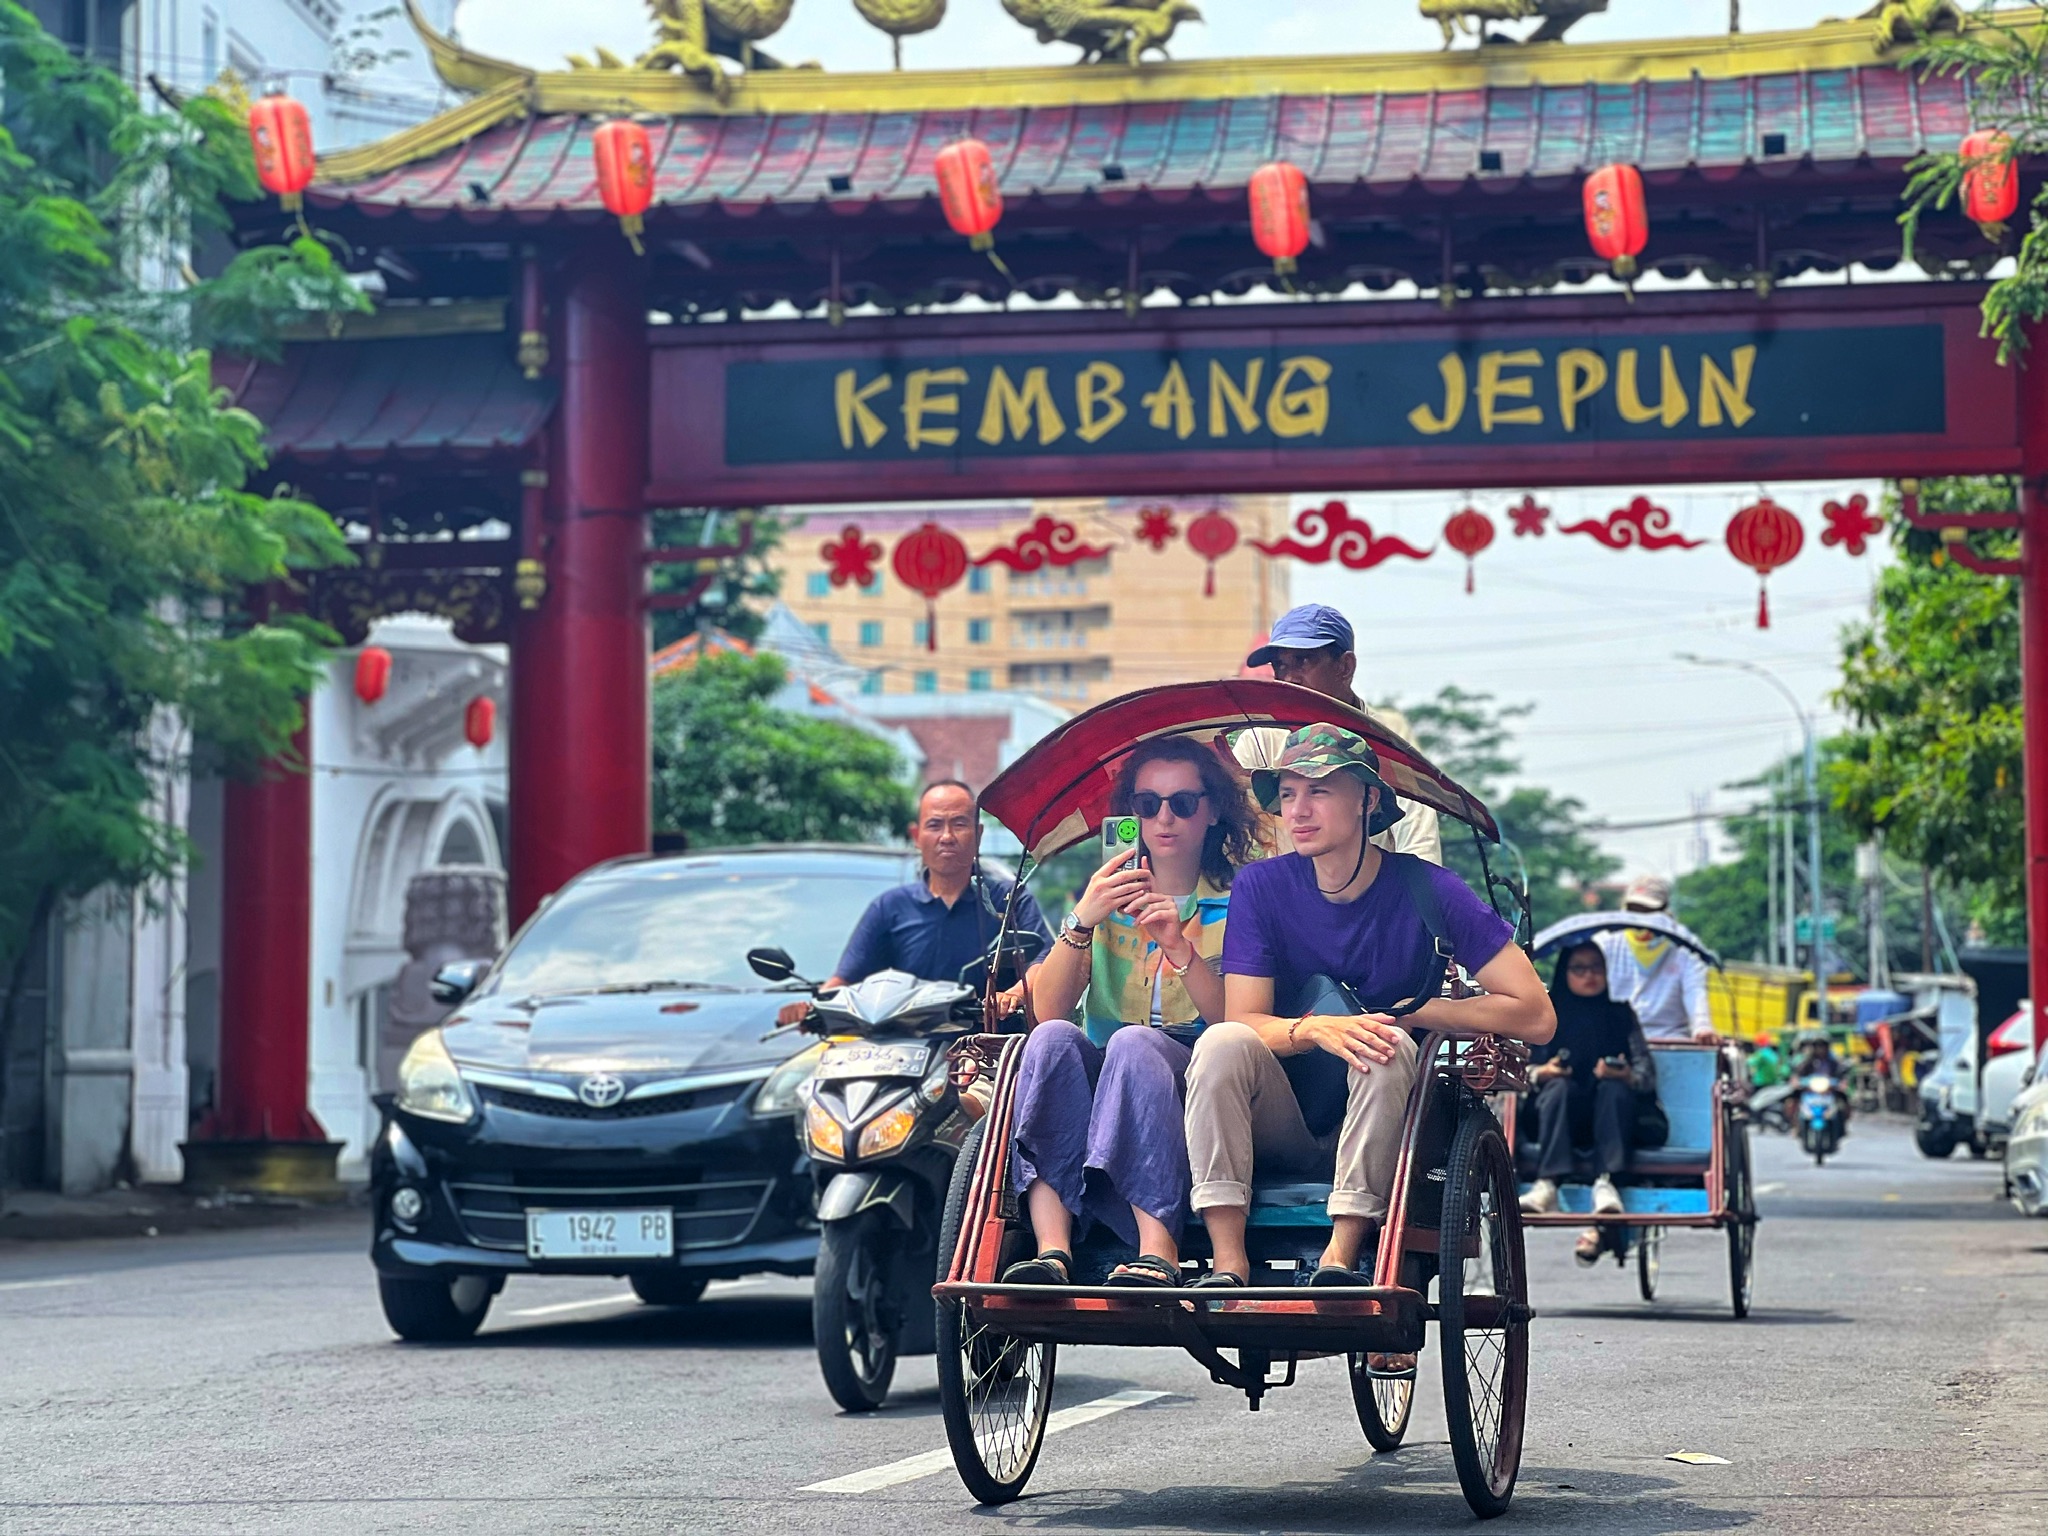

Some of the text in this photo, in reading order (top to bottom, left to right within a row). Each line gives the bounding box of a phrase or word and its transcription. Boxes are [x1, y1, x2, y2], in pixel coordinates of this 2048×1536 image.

[834, 344, 1757, 451] KEMBANG JEPUN
[933, 1109, 960, 1137] HONDA
[532, 1215, 667, 1242] L 1942 PB
